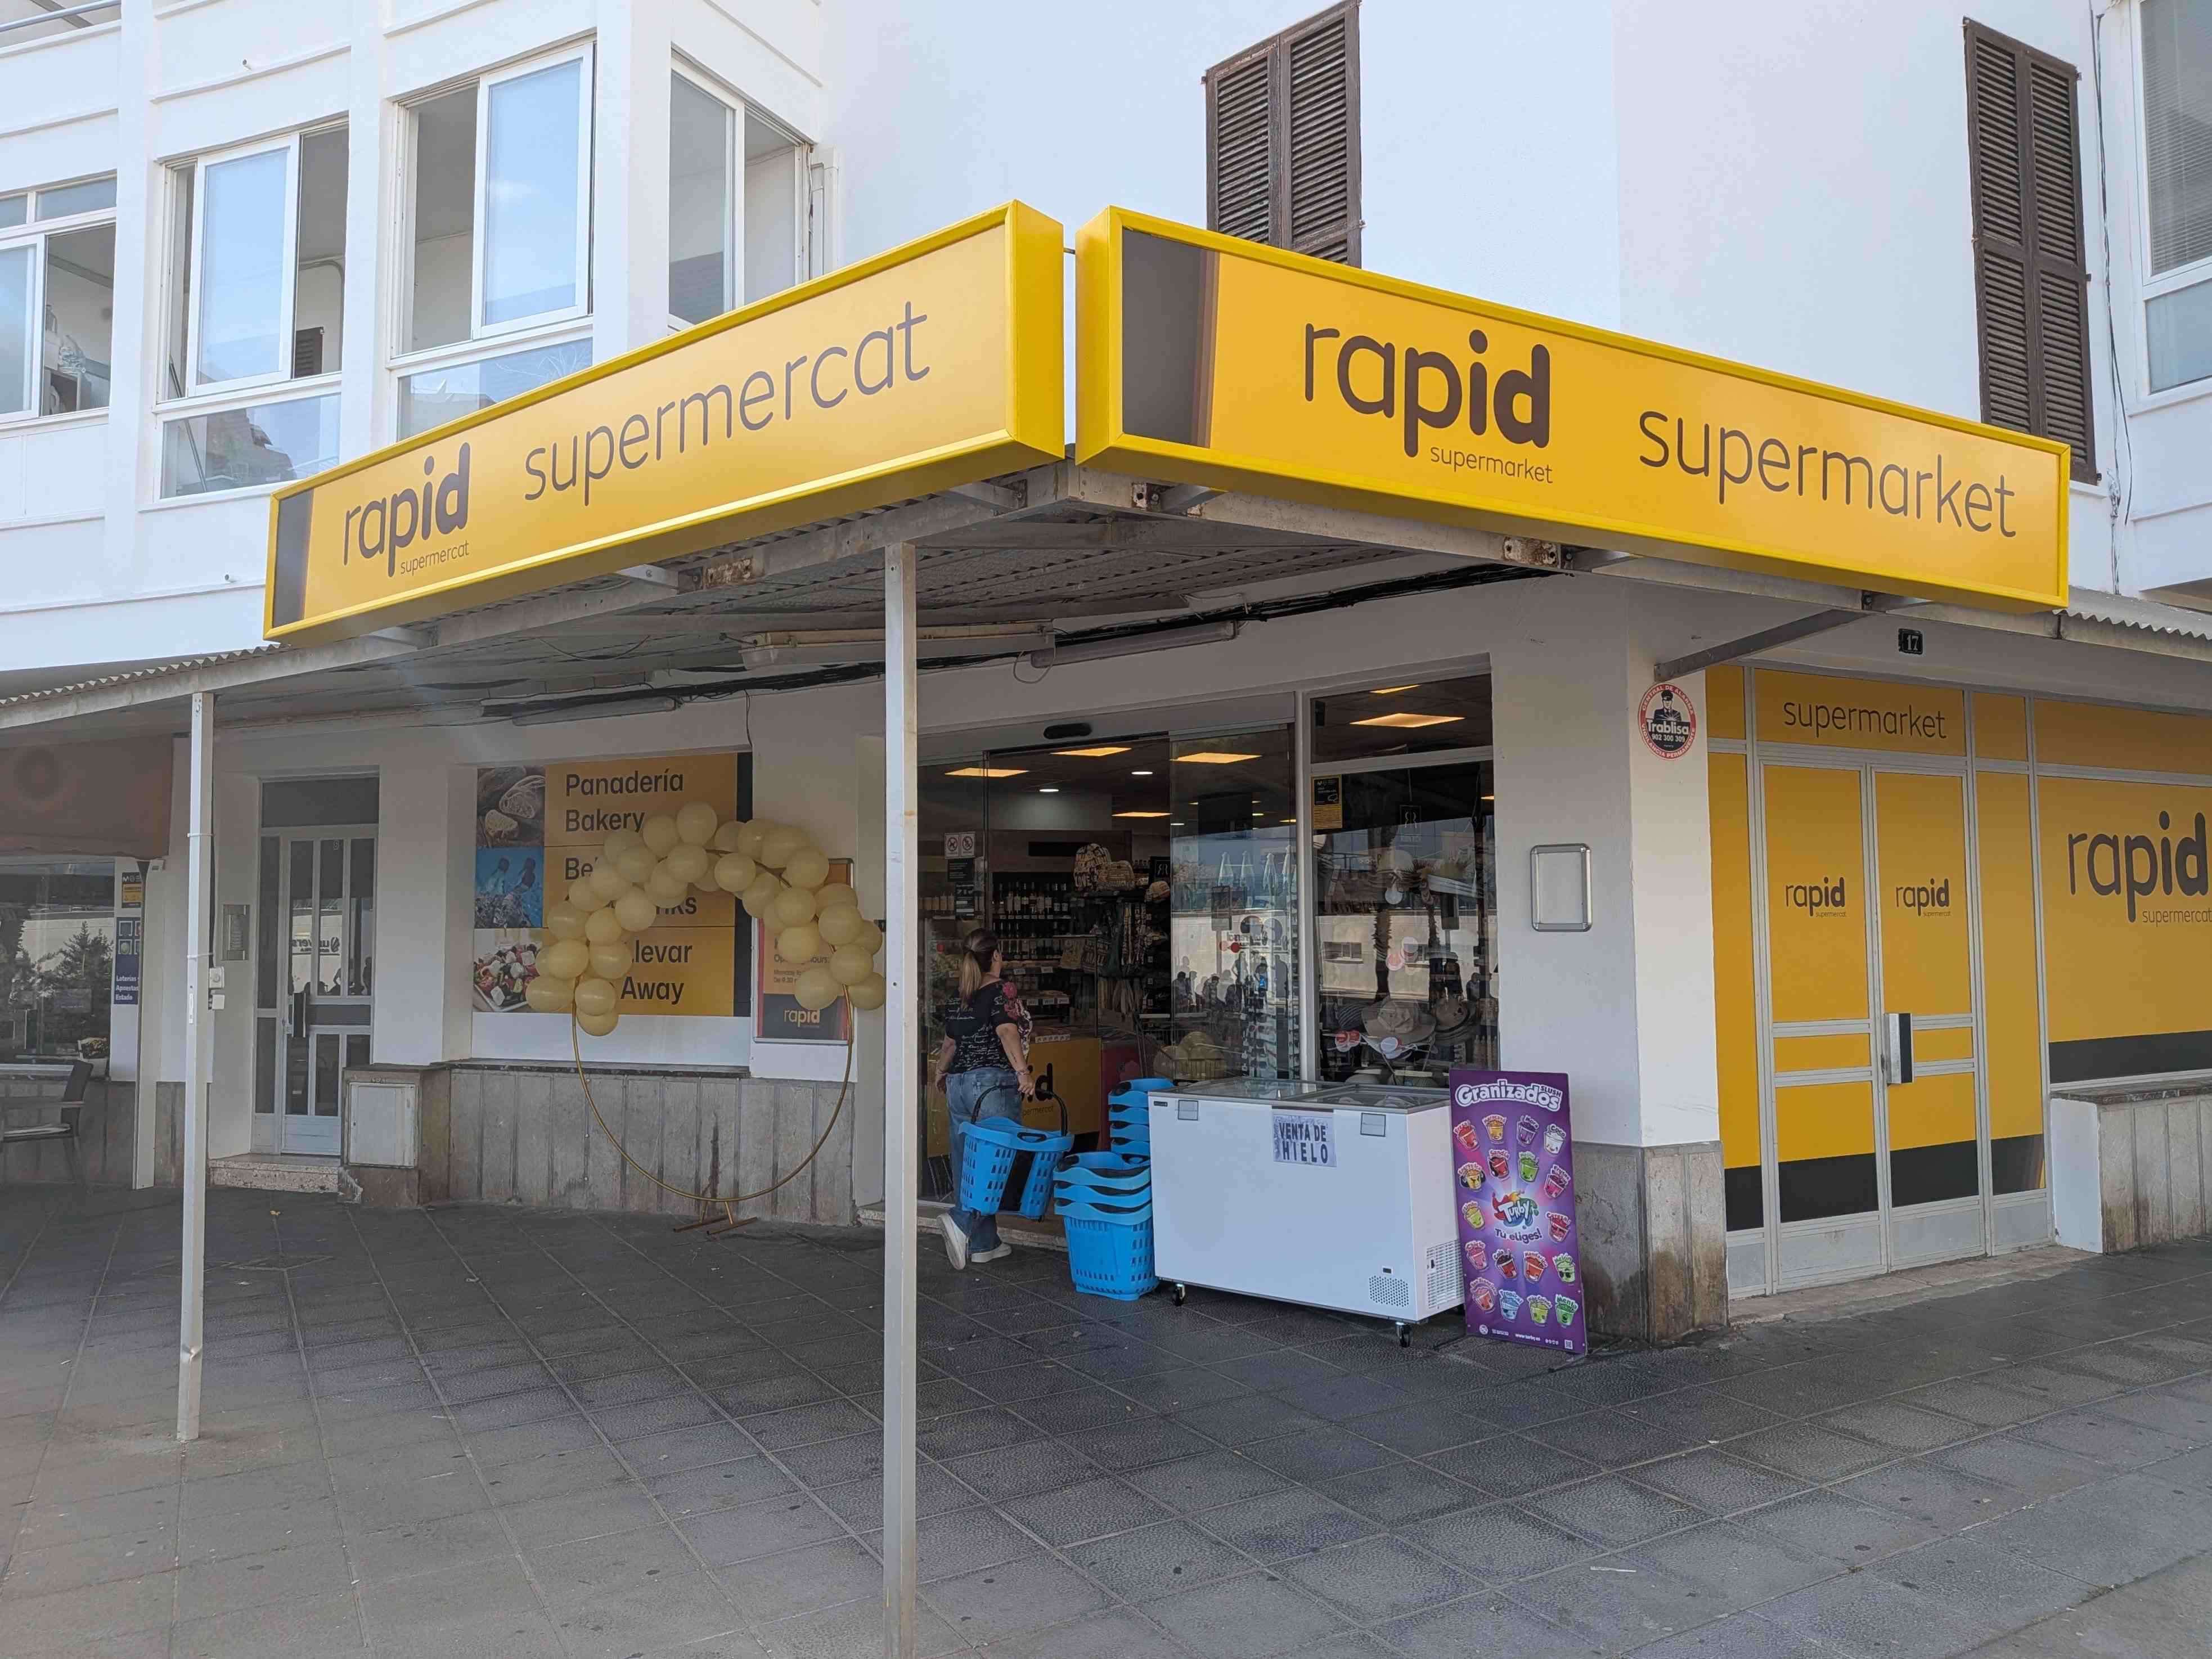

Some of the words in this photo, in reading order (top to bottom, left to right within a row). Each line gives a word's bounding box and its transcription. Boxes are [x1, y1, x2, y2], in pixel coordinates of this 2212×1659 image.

[524, 301, 930, 506] supermercat
[1305, 322, 1550, 458] rapid
[1430, 447, 1553, 484] supermarket
[1639, 411, 2017, 538] supermarket
[344, 442, 471, 577] rapid
[400, 539, 470, 577] supermercat
[1907, 634, 1919, 651] 17
[1646, 720, 1689, 735] Trablisa
[1783, 702, 1947, 739] supermarket
[1663, 734, 1674, 742] 300
[565, 768, 684, 797] Panadería
[565, 808, 645, 833] Bakery
[2067, 810, 2209, 923] rapid
[1785, 876, 1846, 917] rapid
[1895, 878, 1950, 916] rapid
[2142, 908, 2212, 928] supermercat
[632, 939, 693, 963] levar
[620, 976, 685, 1005] Away
[1456, 1080, 1561, 1111] Granizados
[1540, 1085, 1562, 1098] SLUSH
[1279, 1122, 1311, 1141] VENTA
[1314, 1125, 1327, 1142] DE
[1282, 1140, 1328, 1163] HIELO
[1509, 1228, 1543, 1244] eliges!
